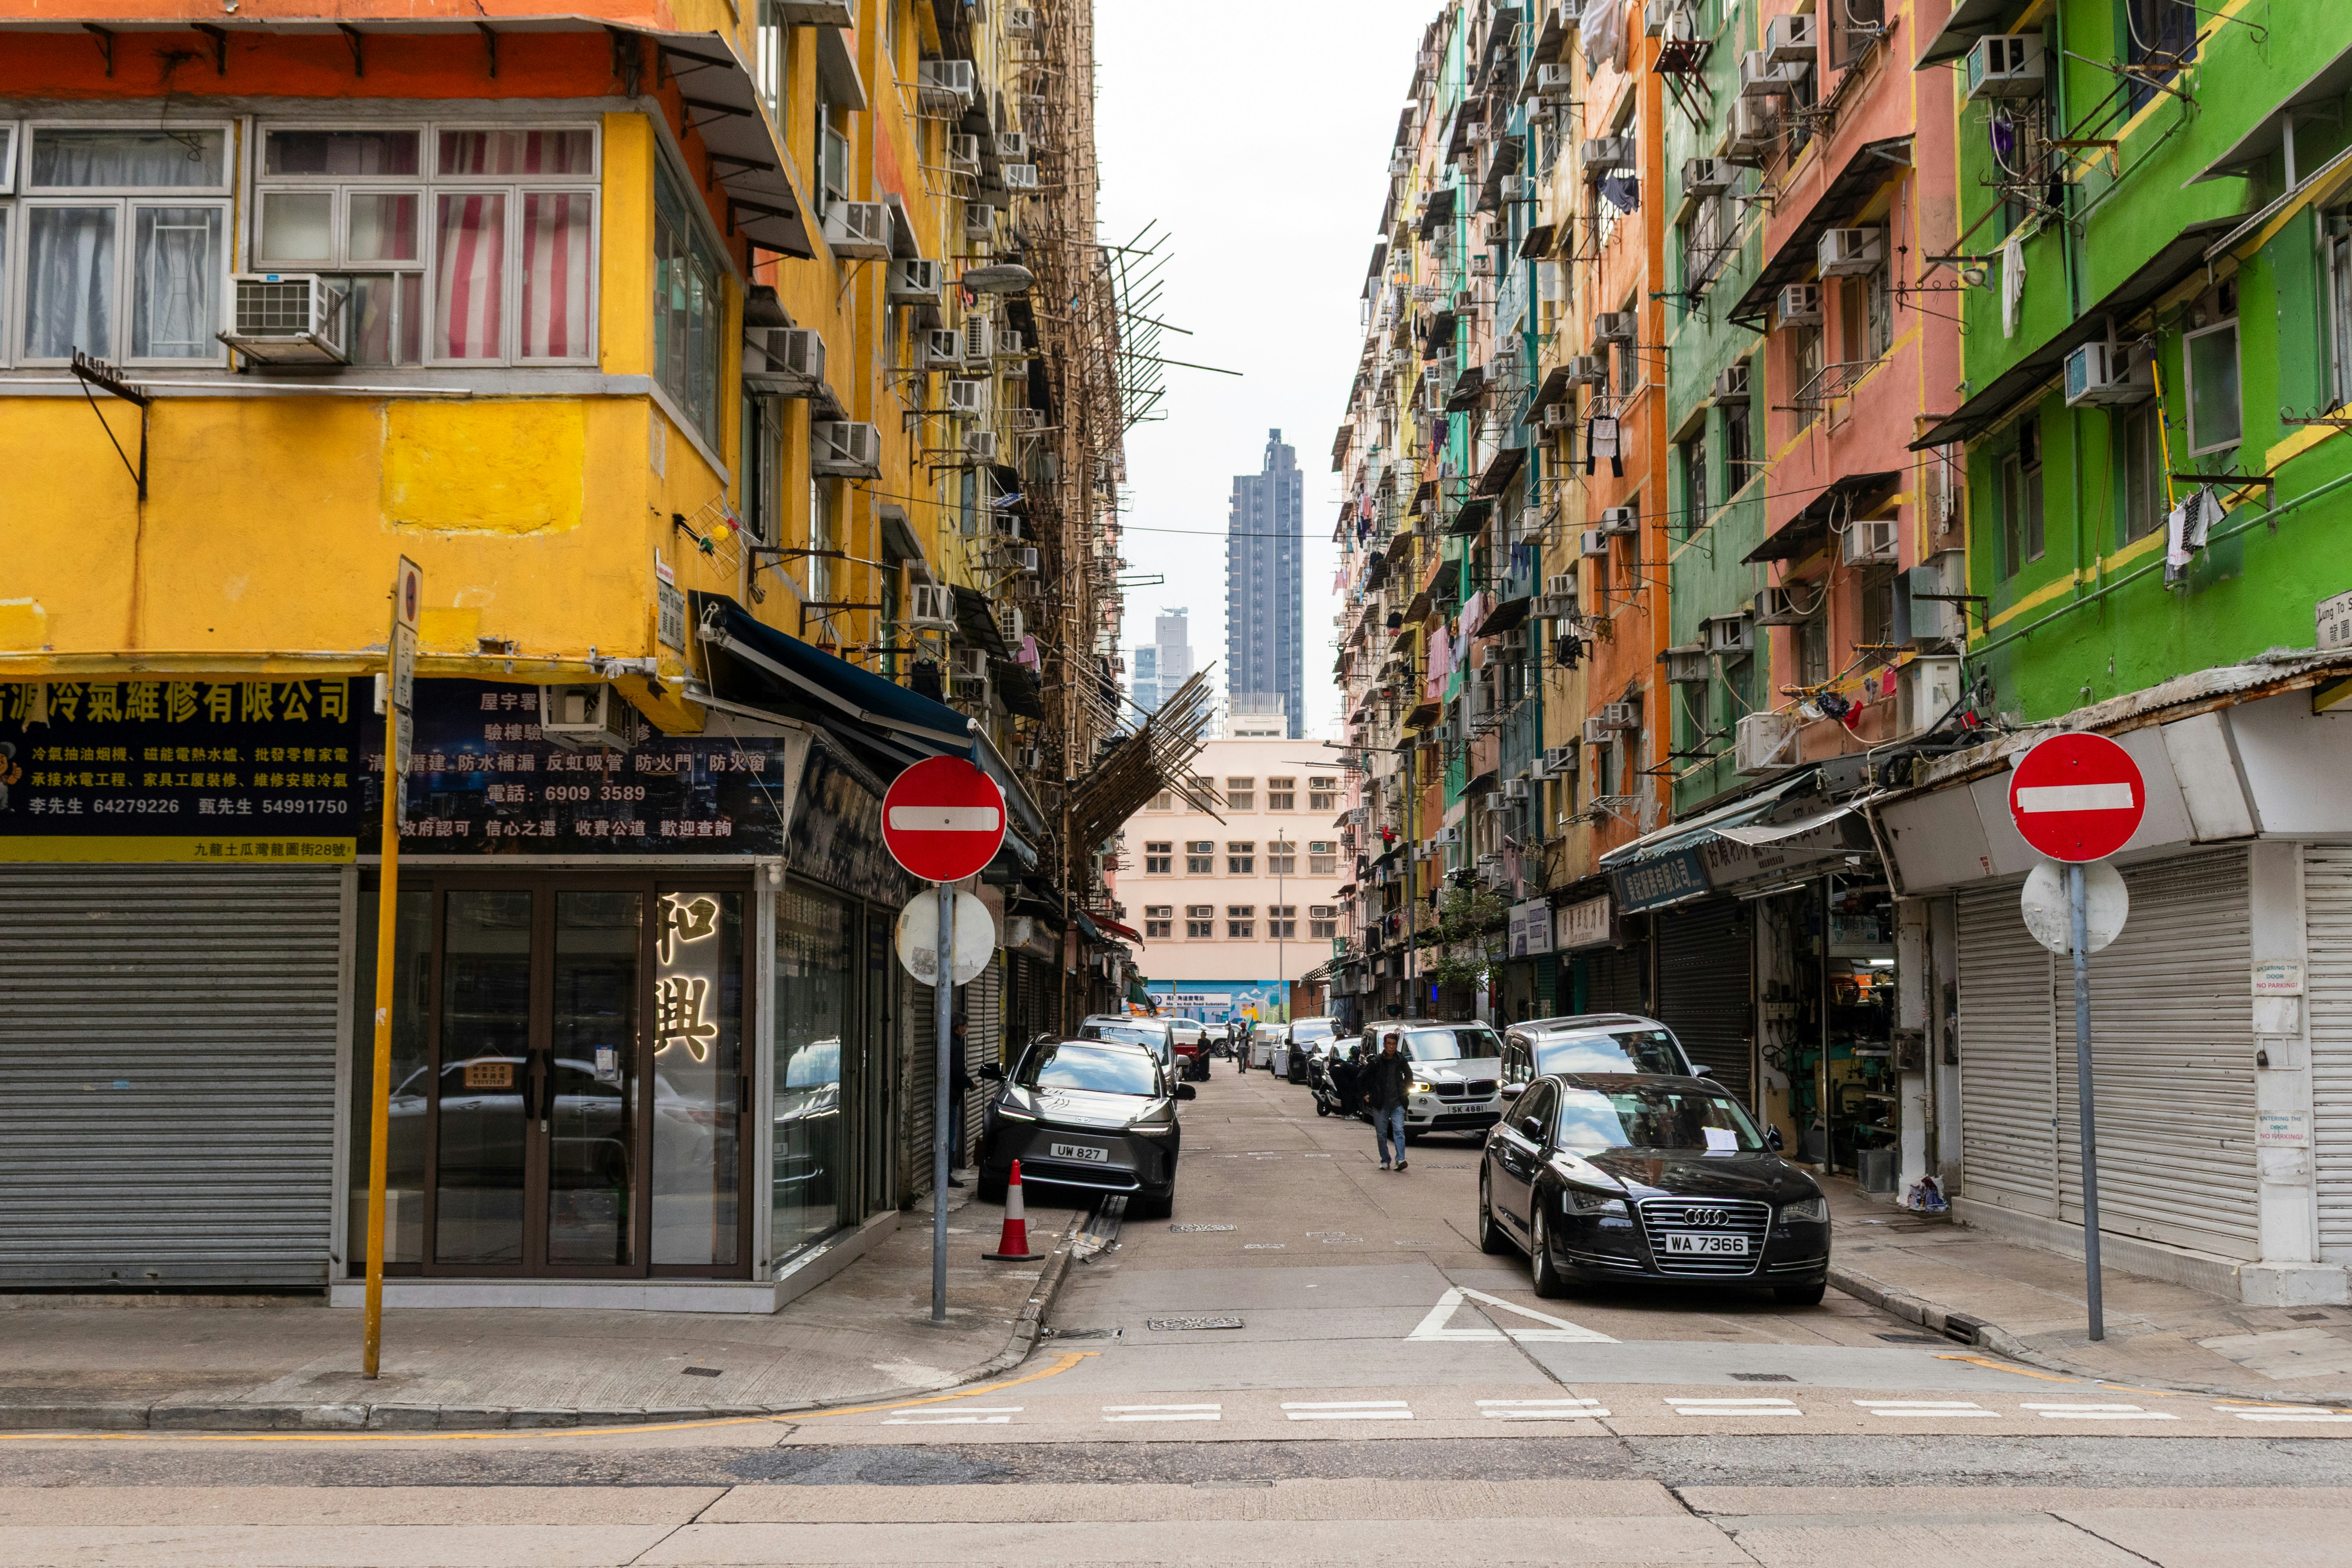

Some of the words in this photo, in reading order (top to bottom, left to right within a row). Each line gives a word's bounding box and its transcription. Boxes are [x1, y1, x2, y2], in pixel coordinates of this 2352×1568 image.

[2318, 608, 2333, 620] Lung
[2336, 602, 2344, 614] To
[0, 679, 349, 723] 源冷氣維修有限公司
[481, 693, 552, 710] 屋宇署
[368, 754, 446, 772] 清僭建
[458, 754, 535, 772] 防水補漏
[546, 754, 623, 772] 反虹吸管
[635, 754, 691, 772] 防火門
[709, 754, 767, 772] 防火窗
[545, 786, 590, 800] 6909
[600, 786, 645, 800] 3589
[30, 797, 83, 814] 李先生
[94, 799, 179, 813] 64279226
[199, 798, 252, 815] 甄先生
[263, 800, 347, 813] 54991750
[400, 820, 471, 837] 政府認可
[486, 820, 556, 837] 信心之選
[575, 820, 645, 837] 收費公道
[660, 820, 732, 837] 歡迎查詢
[194, 842, 346, 857] 九龍土瓜灣龍圖街28號
[1058, 1146, 1073, 1157] UW
[1077, 1148, 1101, 1160] 827
[1671, 1237, 1693, 1251] WA
[1698, 1237, 1743, 1252] 7366
